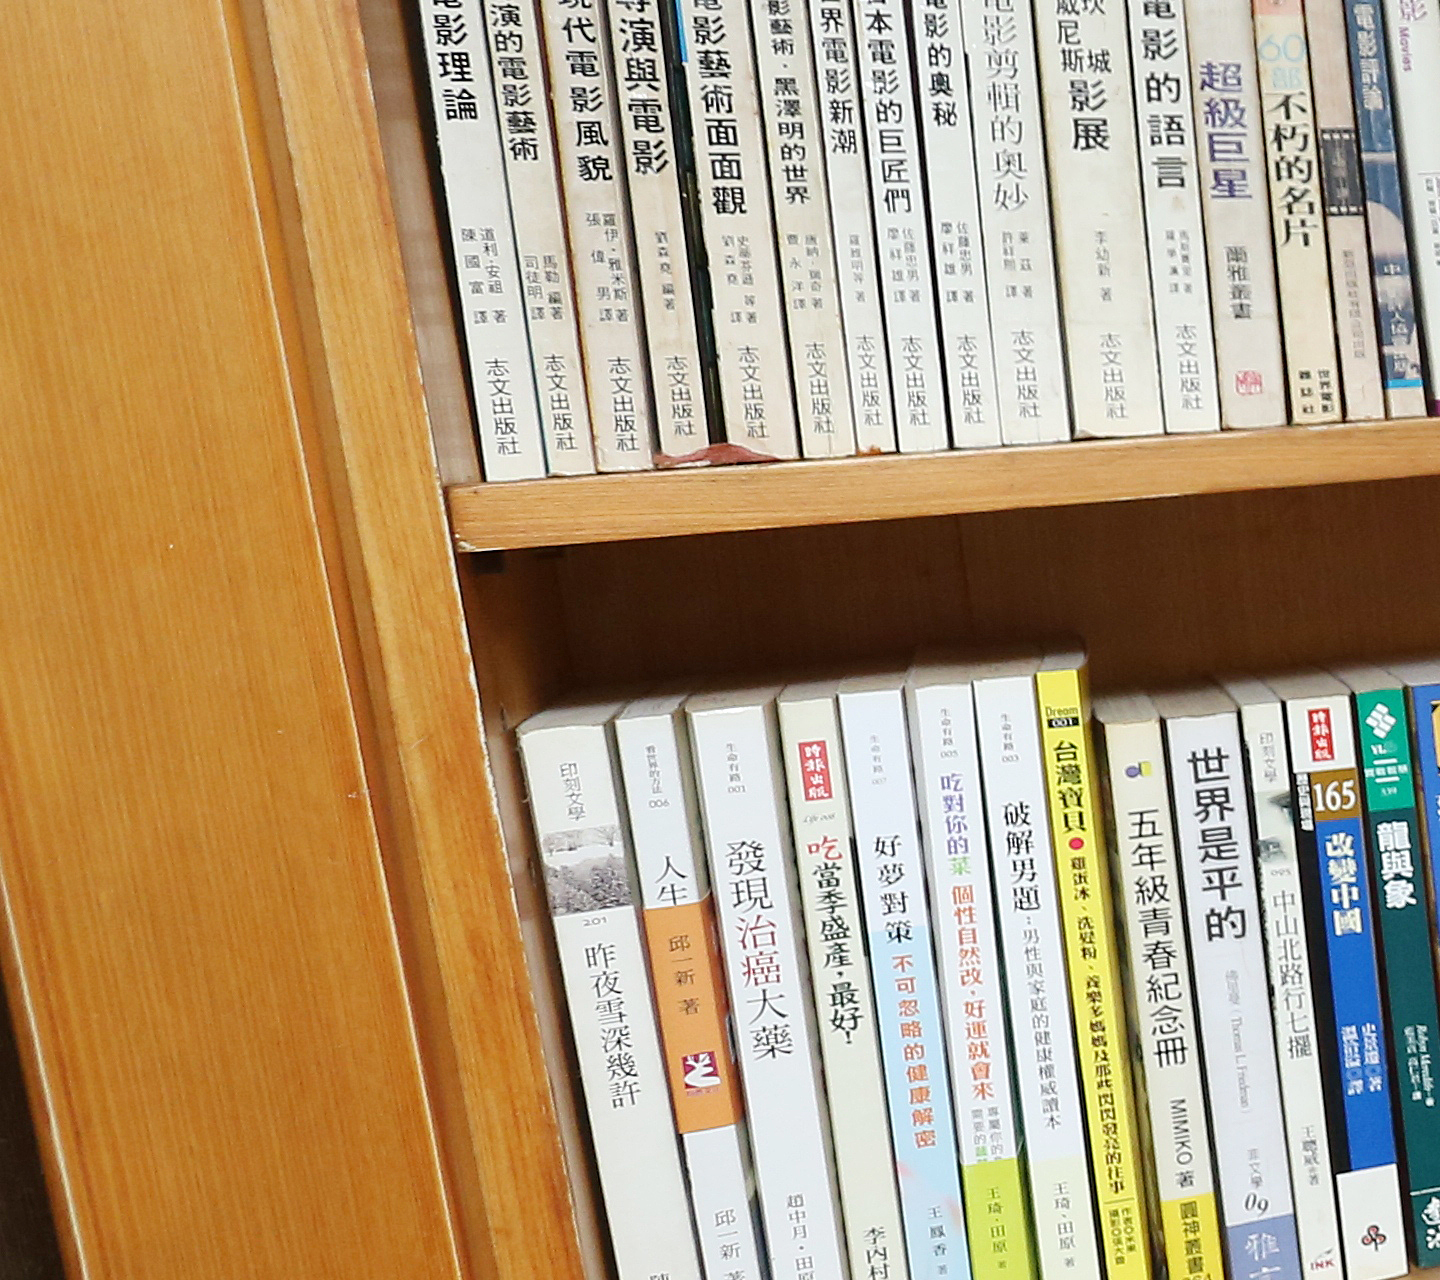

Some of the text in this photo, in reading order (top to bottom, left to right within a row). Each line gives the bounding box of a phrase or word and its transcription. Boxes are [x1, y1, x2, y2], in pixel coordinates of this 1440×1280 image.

[1257, 34, 1307, 63] 60
[1199, 61, 1253, 200] 超級巨星
[1264, 92, 1319, 248] 不朽的名片
[484, 356, 523, 456] 志文出版社
[543, 353, 579, 452] 志文出版社
[608, 355, 641, 453] 志文出版社
[665, 354, 698, 438] 志文出版社
[737, 344, 771, 440] 志文出版社
[804, 342, 836, 435] 志文出版社
[855, 334, 885, 427] 志文出版社
[900, 334, 931, 427] 志文出版社
[956, 333, 986, 426] 志文出版社
[1010, 329, 1042, 420] 志文出版社
[1099, 332, 1130, 419] 志文出版社
[1175, 323, 1204, 411] 志文出版社
[1051, 739, 1088, 834] 台灣寶貝
[1314, 778, 1357, 812] 165
[654, 854, 690, 906] 人生
[1187, 746, 1248, 942] 世界是平的
[1324, 831, 1363, 937] 改變中國
[1376, 820, 1417, 910] 龍與象
[558, 762, 587, 822] 印刻文學
[582, 943, 643, 1110] 昨夜雪深幾許
[725, 840, 795, 1062] 發現治癌大藥
[1126, 807, 1190, 1068] 五年級青春紀念冊
[1271, 889, 1314, 1060] 中山北路行七擺
[873, 834, 937, 1149] 好夢對策 不可忽略的健康解密
[1167, 1098, 1195, 1167] MIMIKO
[1178, 1200, 1207, 1273] 圓神叢書
